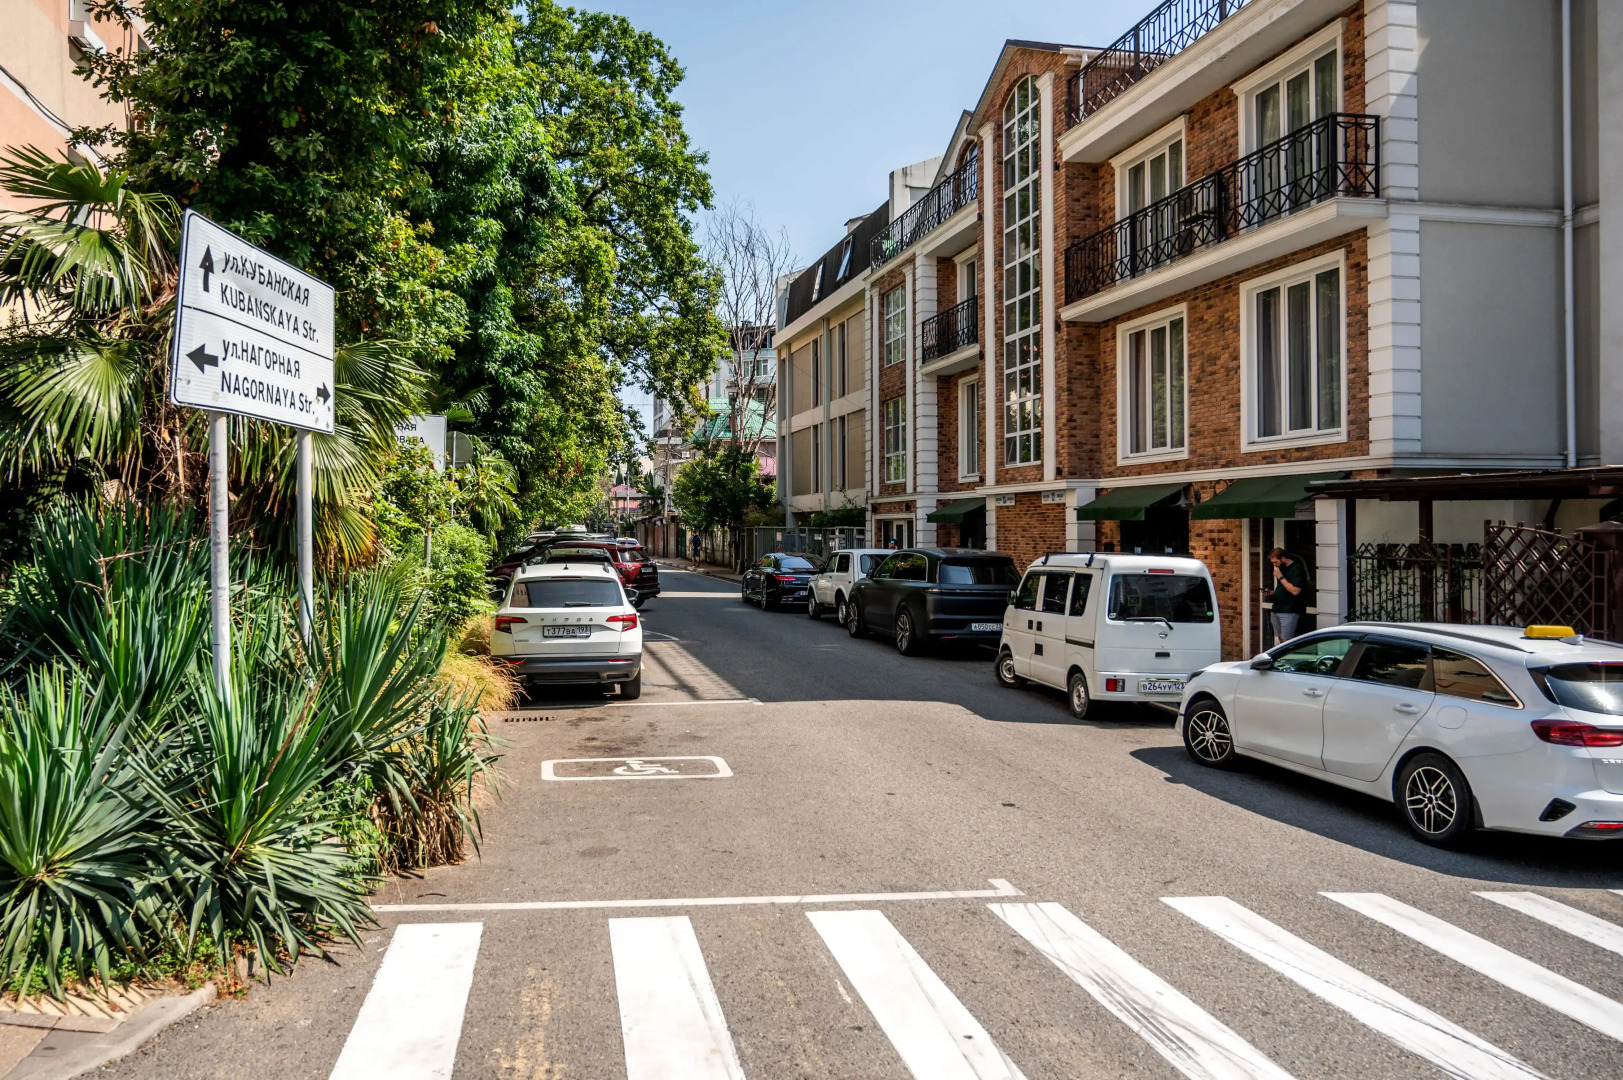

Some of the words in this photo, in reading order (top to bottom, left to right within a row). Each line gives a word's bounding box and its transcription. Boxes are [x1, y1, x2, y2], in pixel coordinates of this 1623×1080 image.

[222, 252, 310, 307] ул.КУБАНСКАЯ
[220, 282, 300, 336] KUBANSKAYA
[302, 320, 319, 343] Str.
[222, 339, 300, 379] ул.НАГОРНАЯ
[221, 370, 296, 411] NAGORNAYA
[298, 392, 315, 415] Str.
